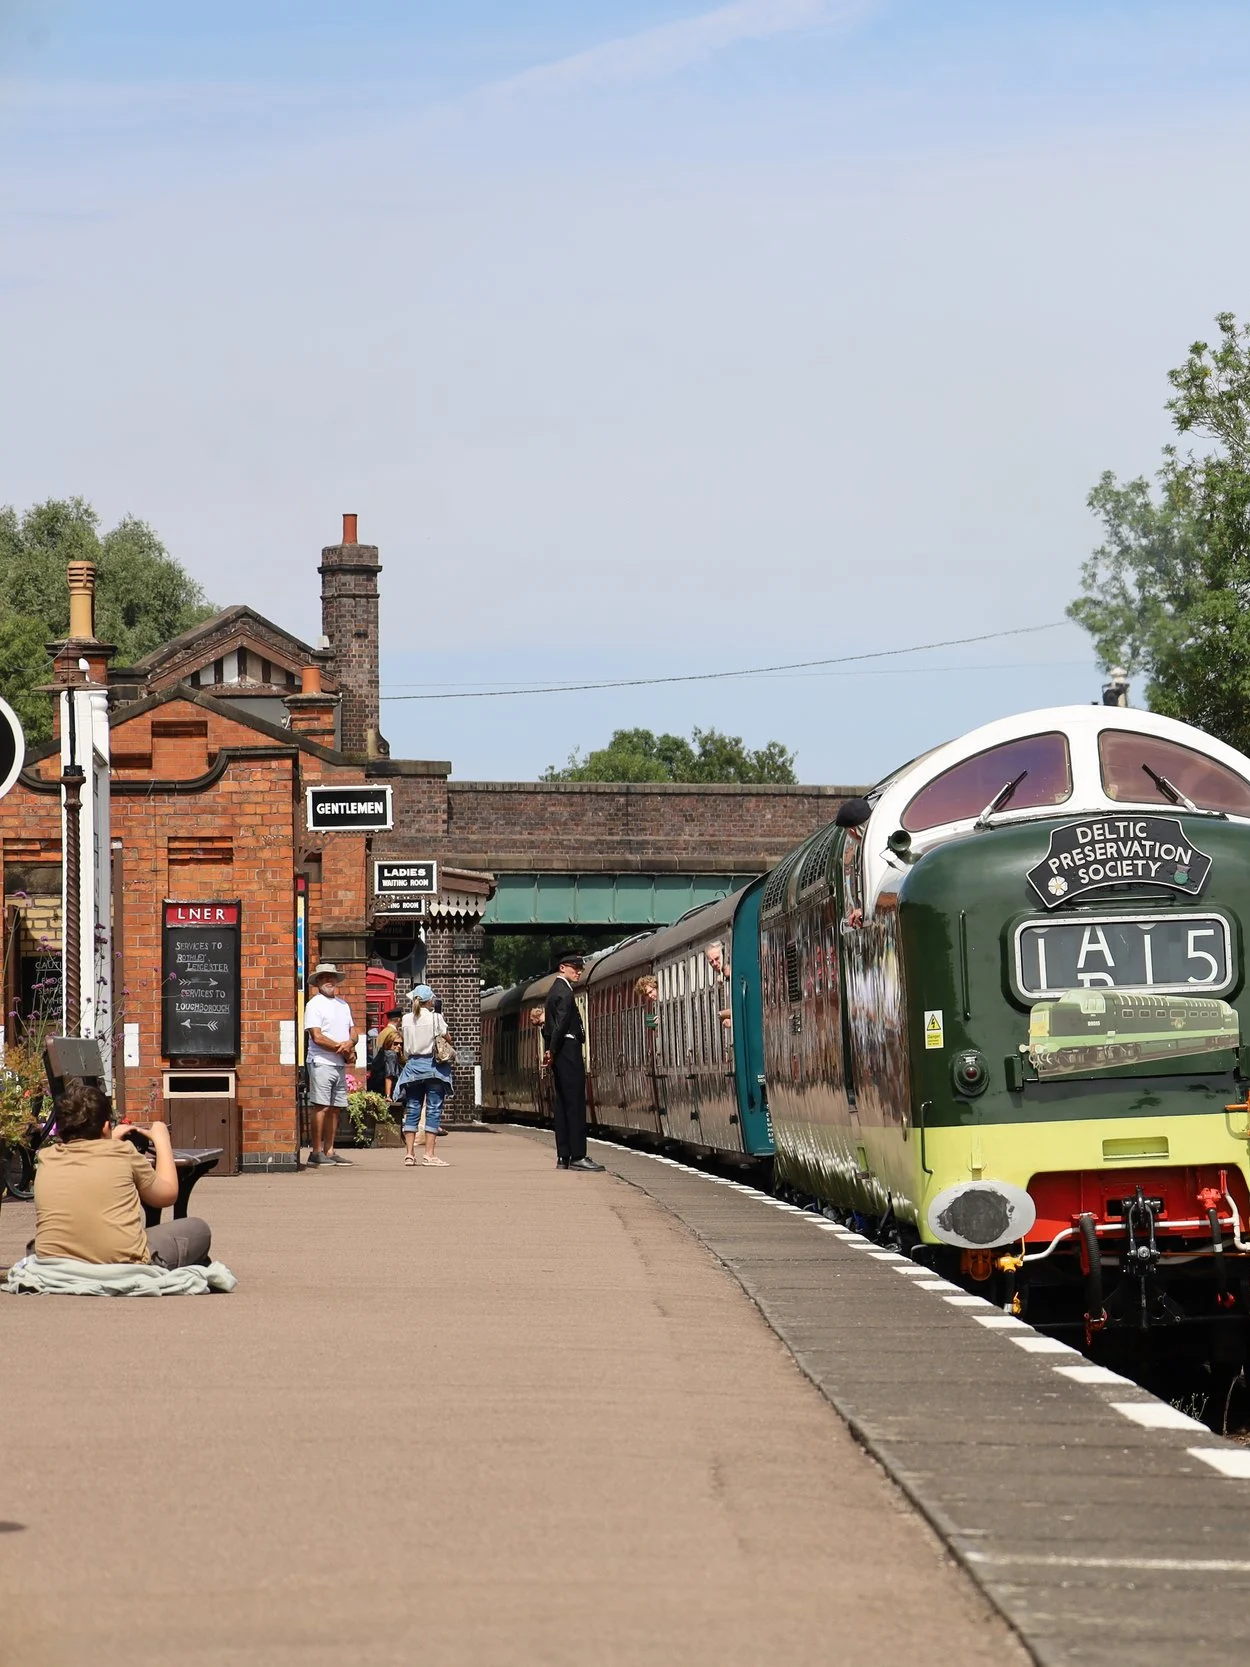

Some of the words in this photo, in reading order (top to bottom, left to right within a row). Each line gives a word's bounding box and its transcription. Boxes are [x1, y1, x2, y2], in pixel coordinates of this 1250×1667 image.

[316, 801, 384, 815] GENTLEMEN
[1075, 821, 1148, 844] DELTIC
[1047, 839, 1192, 875] PRESERVATION
[383, 868, 427, 877] LADIES
[1077, 860, 1162, 884] SOCIETY
[382, 879, 408, 887] WAITING
[410, 878, 429, 887] ROOM
[402, 901, 419, 909] ROOM
[177, 908, 225, 920] LNER
[175, 942, 209, 951] SERVICES
[212, 941, 223, 950] TO
[185, 963, 229, 973] LEICESTER
[180, 989, 214, 998] SERVICES
[215, 989, 226, 998] TO
[175, 1002, 230, 1013] LOUGHBOROUGH
